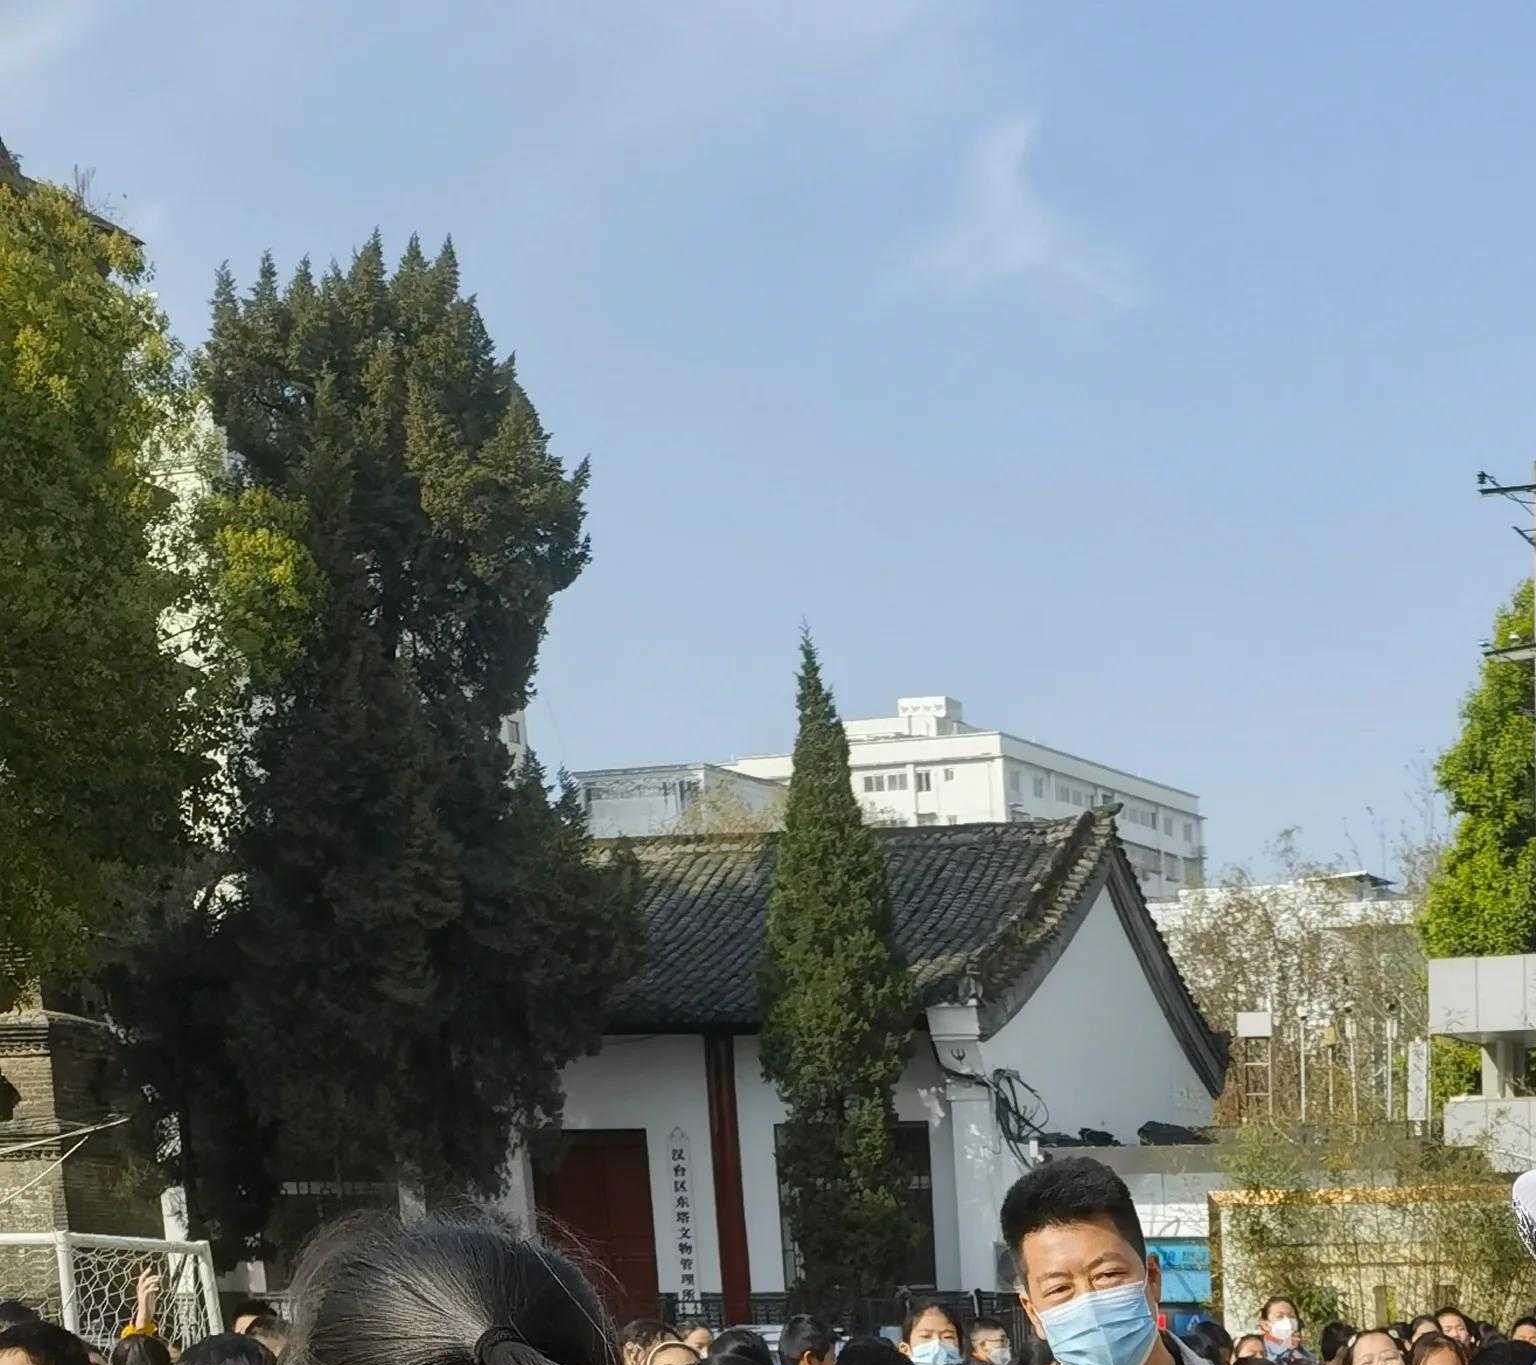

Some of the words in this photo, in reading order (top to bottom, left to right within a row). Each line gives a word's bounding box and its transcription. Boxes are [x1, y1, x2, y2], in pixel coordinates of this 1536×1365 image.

[671, 1148, 696, 1301] 汉台区东塔文物管理所
